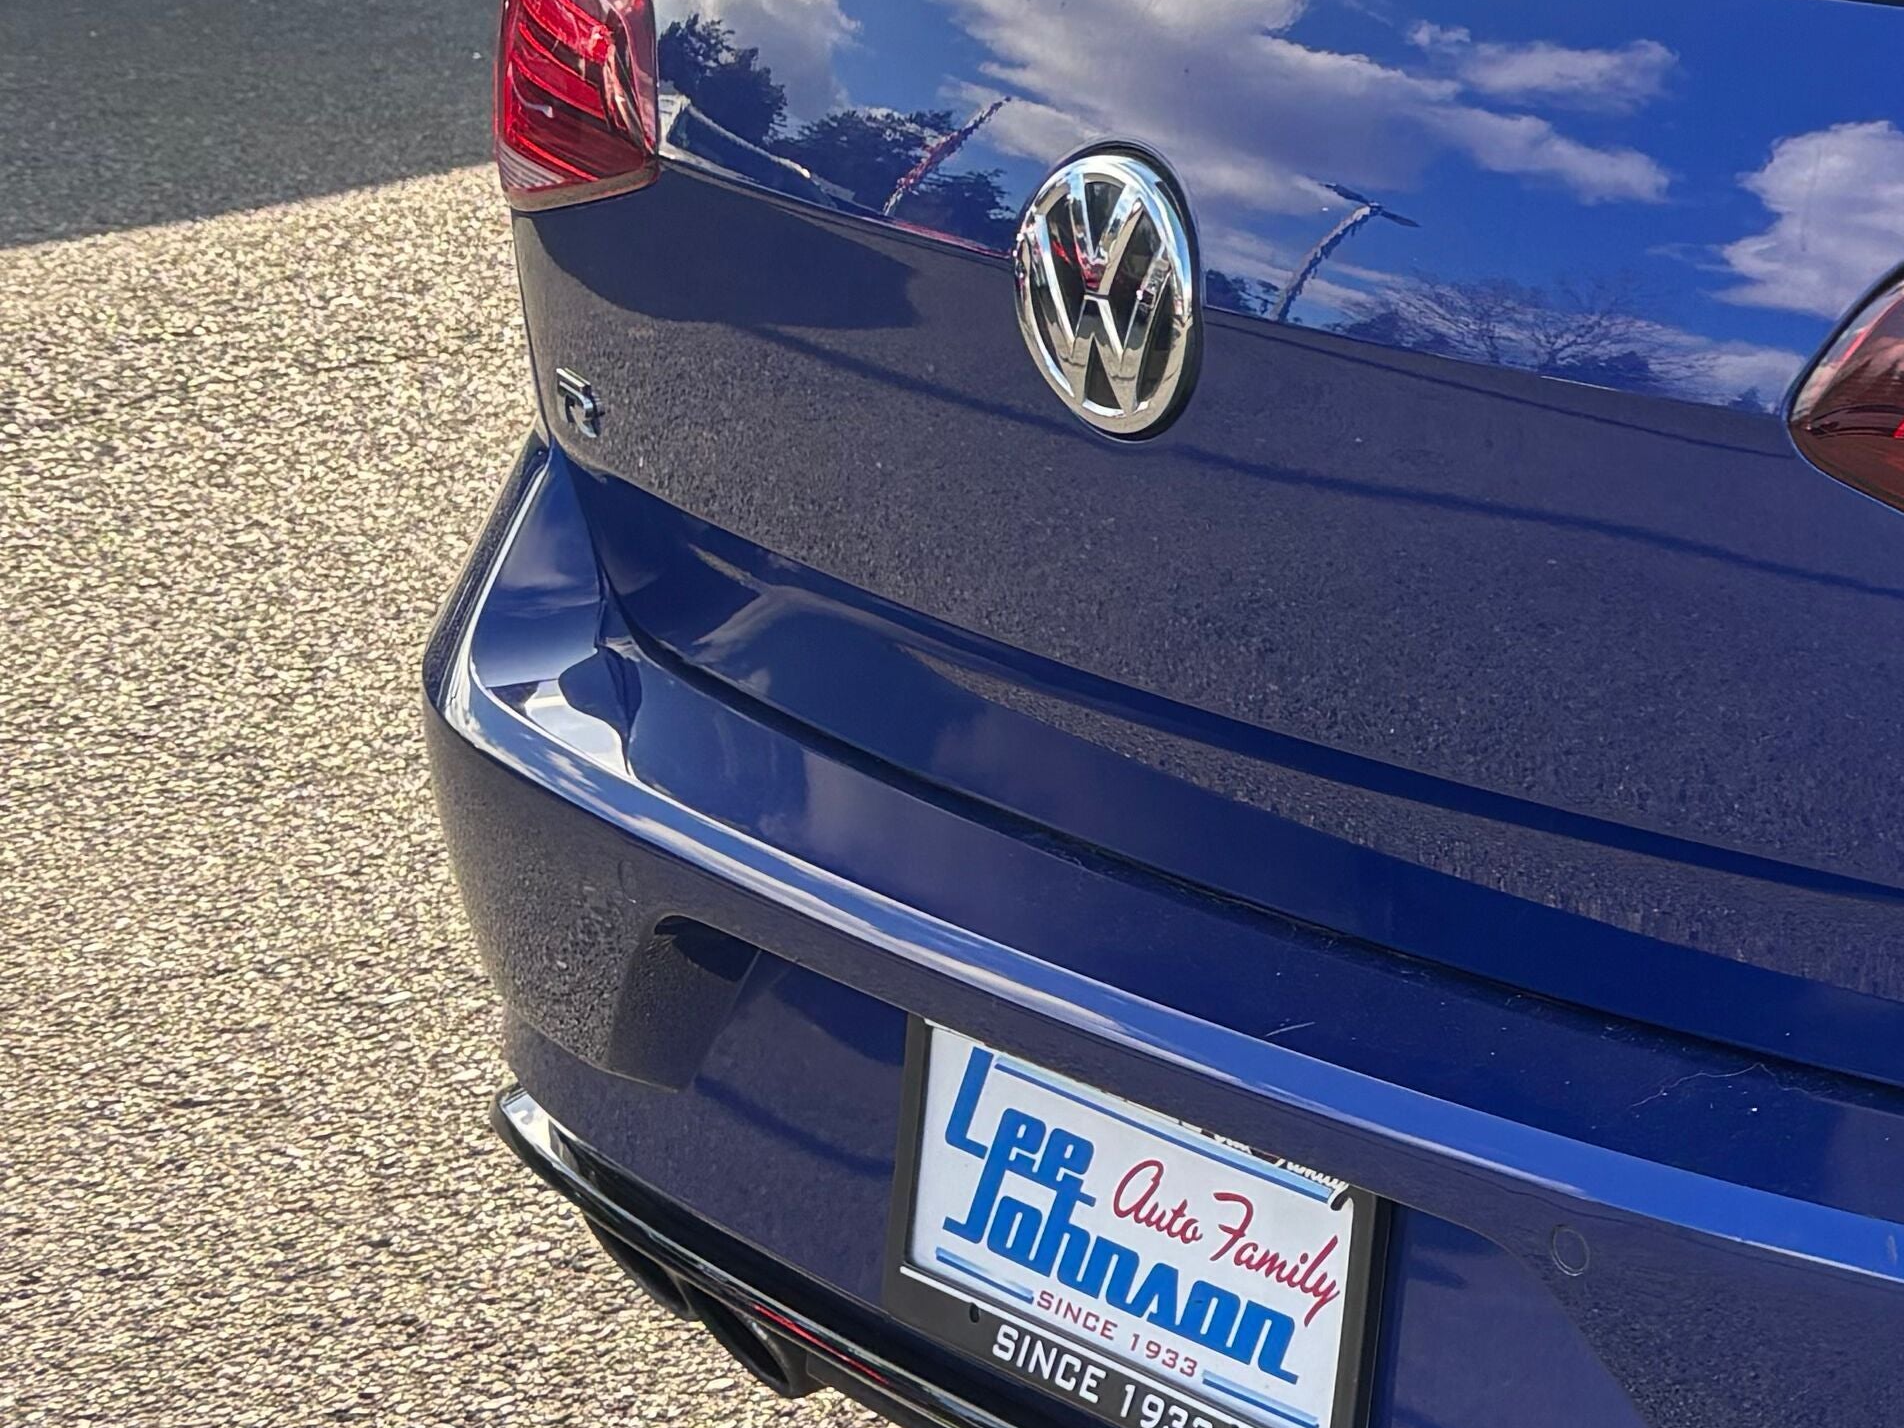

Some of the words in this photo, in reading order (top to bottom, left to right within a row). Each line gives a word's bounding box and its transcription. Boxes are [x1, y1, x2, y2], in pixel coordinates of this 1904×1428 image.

[944, 1045, 1096, 1182] Lee
[941, 1155, 1300, 1385] Johnson
[1111, 1158, 1203, 1245] Auto
[1208, 1191, 1341, 1327] Family
[991, 1323, 1107, 1405] SINCE
[1035, 1289, 1119, 1341] SINCE
[1129, 1331, 1199, 1379] 1933
